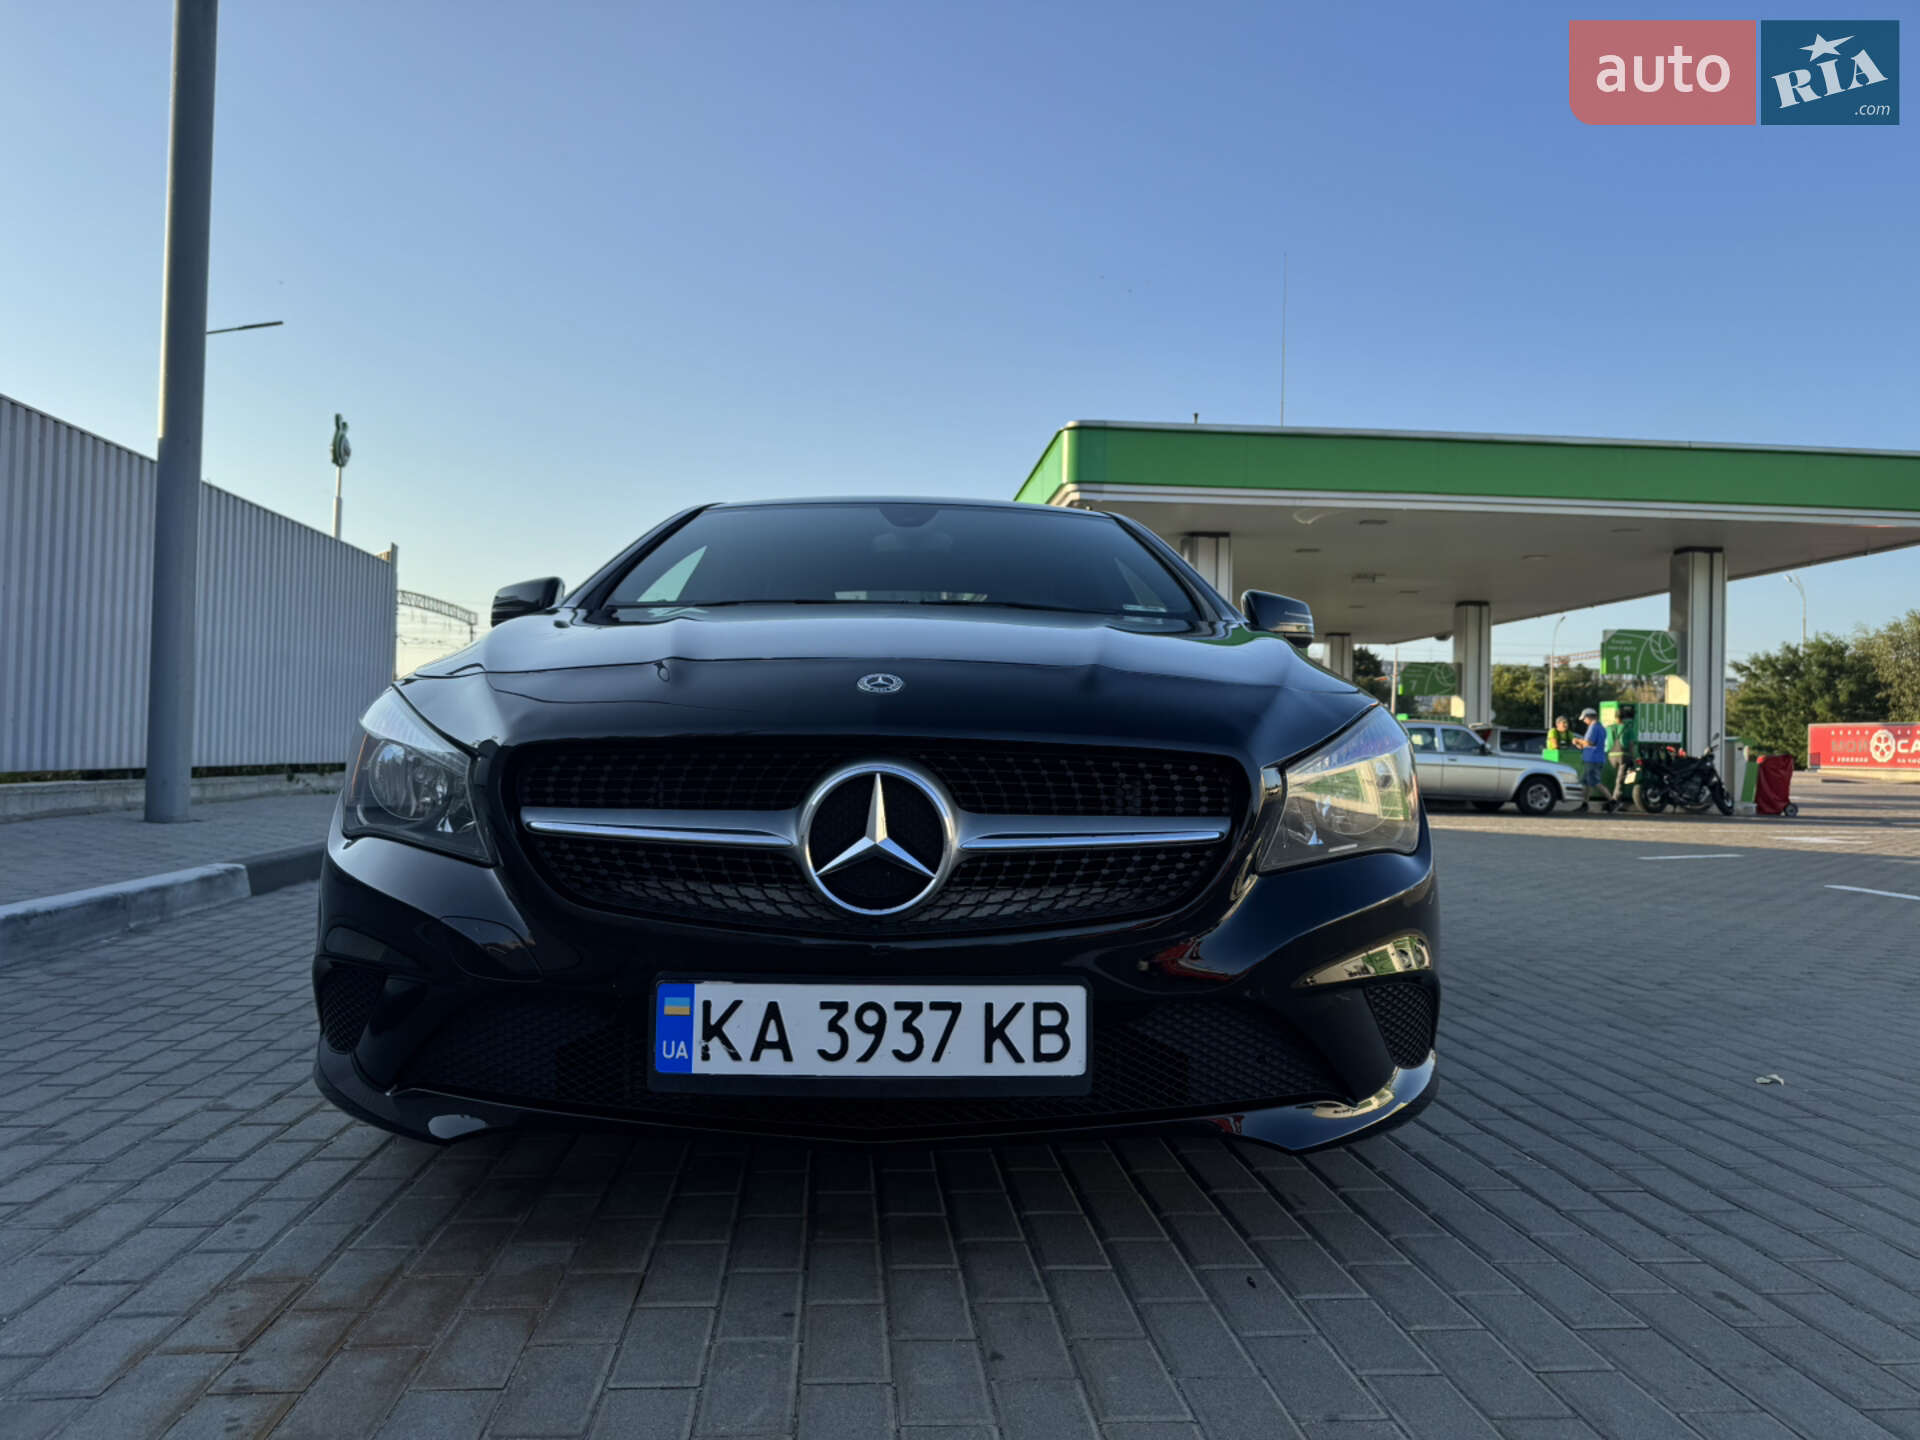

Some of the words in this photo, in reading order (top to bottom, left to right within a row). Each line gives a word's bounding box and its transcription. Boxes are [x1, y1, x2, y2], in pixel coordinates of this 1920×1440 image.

[1612, 654, 1632, 671] 11
[700, 999, 794, 1063] KA
[816, 1000, 963, 1063] 3937
[983, 1001, 1071, 1063] KB
[662, 1039, 689, 1060] UA
